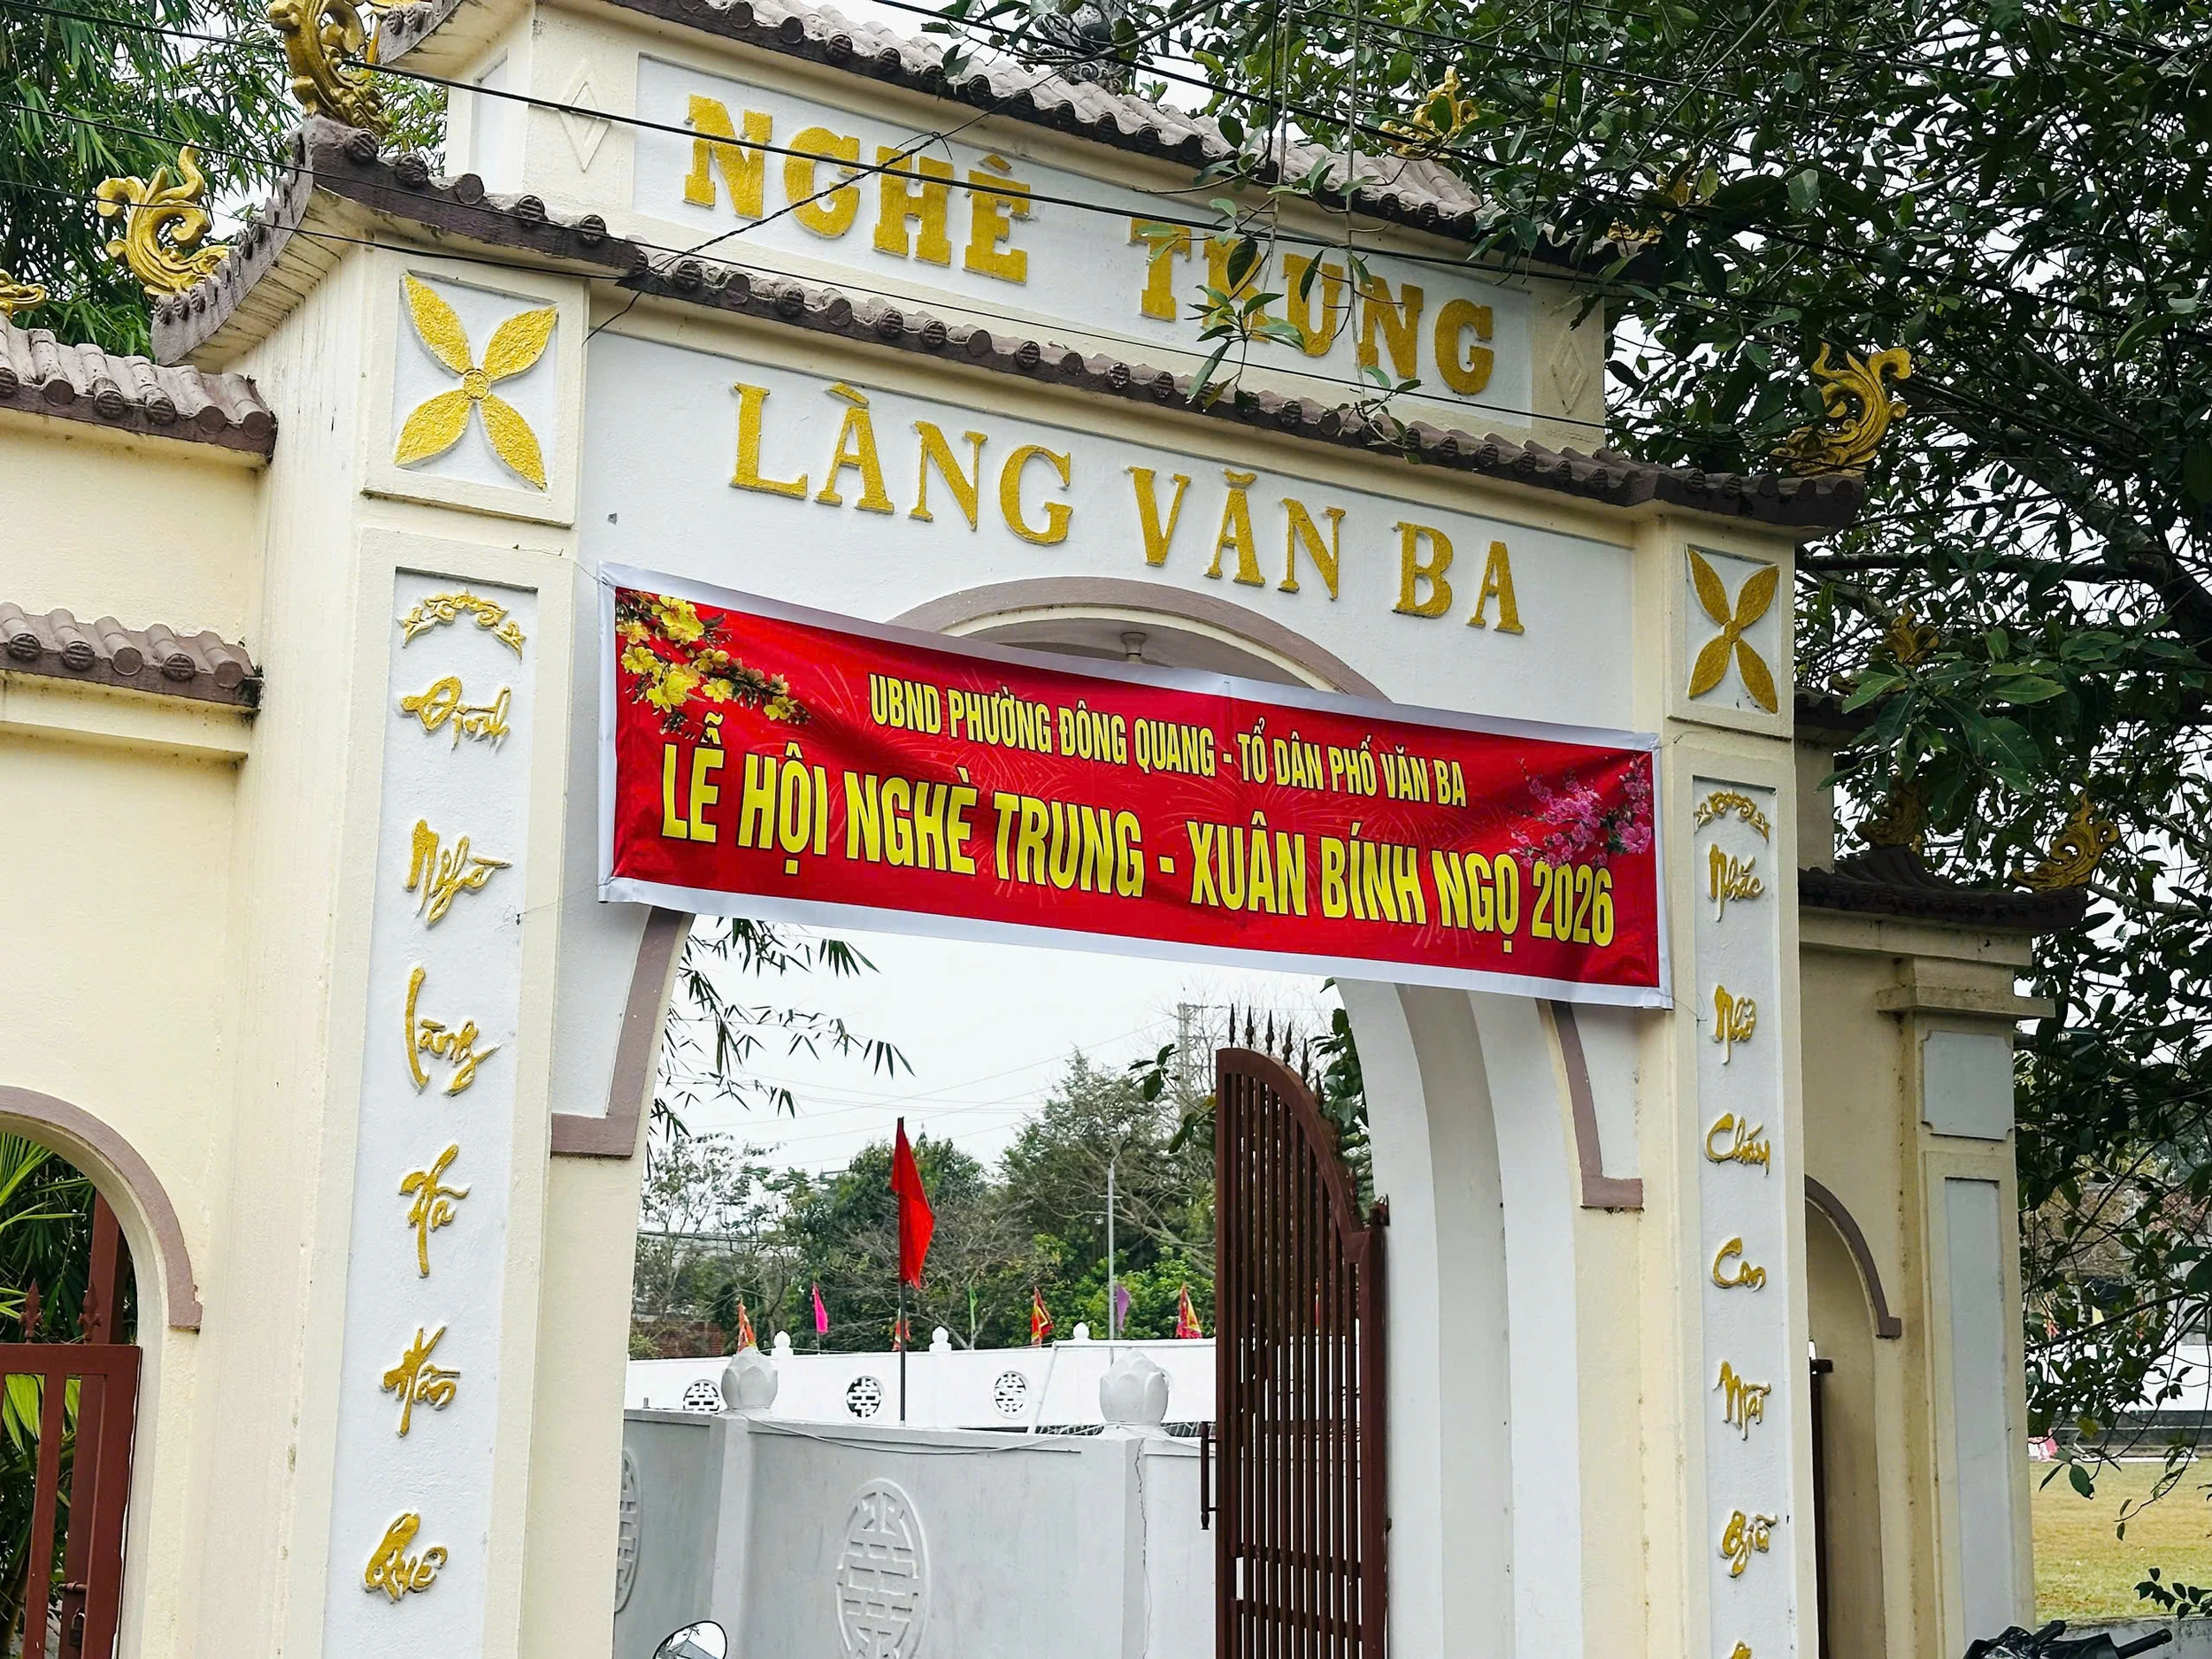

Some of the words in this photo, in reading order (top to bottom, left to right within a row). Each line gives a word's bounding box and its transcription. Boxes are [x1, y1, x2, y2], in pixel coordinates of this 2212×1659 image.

[683, 92, 1032, 285] NGHÈ
[1127, 216, 1495, 396] TRUNG
[729, 379, 1074, 547] LÀNG
[1127, 465, 1347, 602] VĂN
[1391, 518, 1527, 635] BA
[660, 712, 726, 843] LỄ
[737, 741, 828, 876] HỘI
[842, 766, 978, 876] NGHÈ
[993, 791, 1145, 898] TRUNG
[1187, 810, 1308, 917] XUÂN
[1320, 822, 1427, 926] BÍNH
[1431, 849, 1520, 954] NGỌ
[1531, 860, 1616, 948] 2026
[869, 673, 941, 734] UBND
[947, 685, 1052, 754] PHƯỜNG
[1057, 698, 1128, 765] ĐÔNG
[1133, 718, 1216, 777] QUANG
[1236, 716, 1268, 785] TỔ
[1271, 730, 1325, 791] DÂN
[1326, 734, 1378, 798] PHỐ
[1378, 745, 1431, 803] VĂN
[1432, 758, 1467, 809] BA
